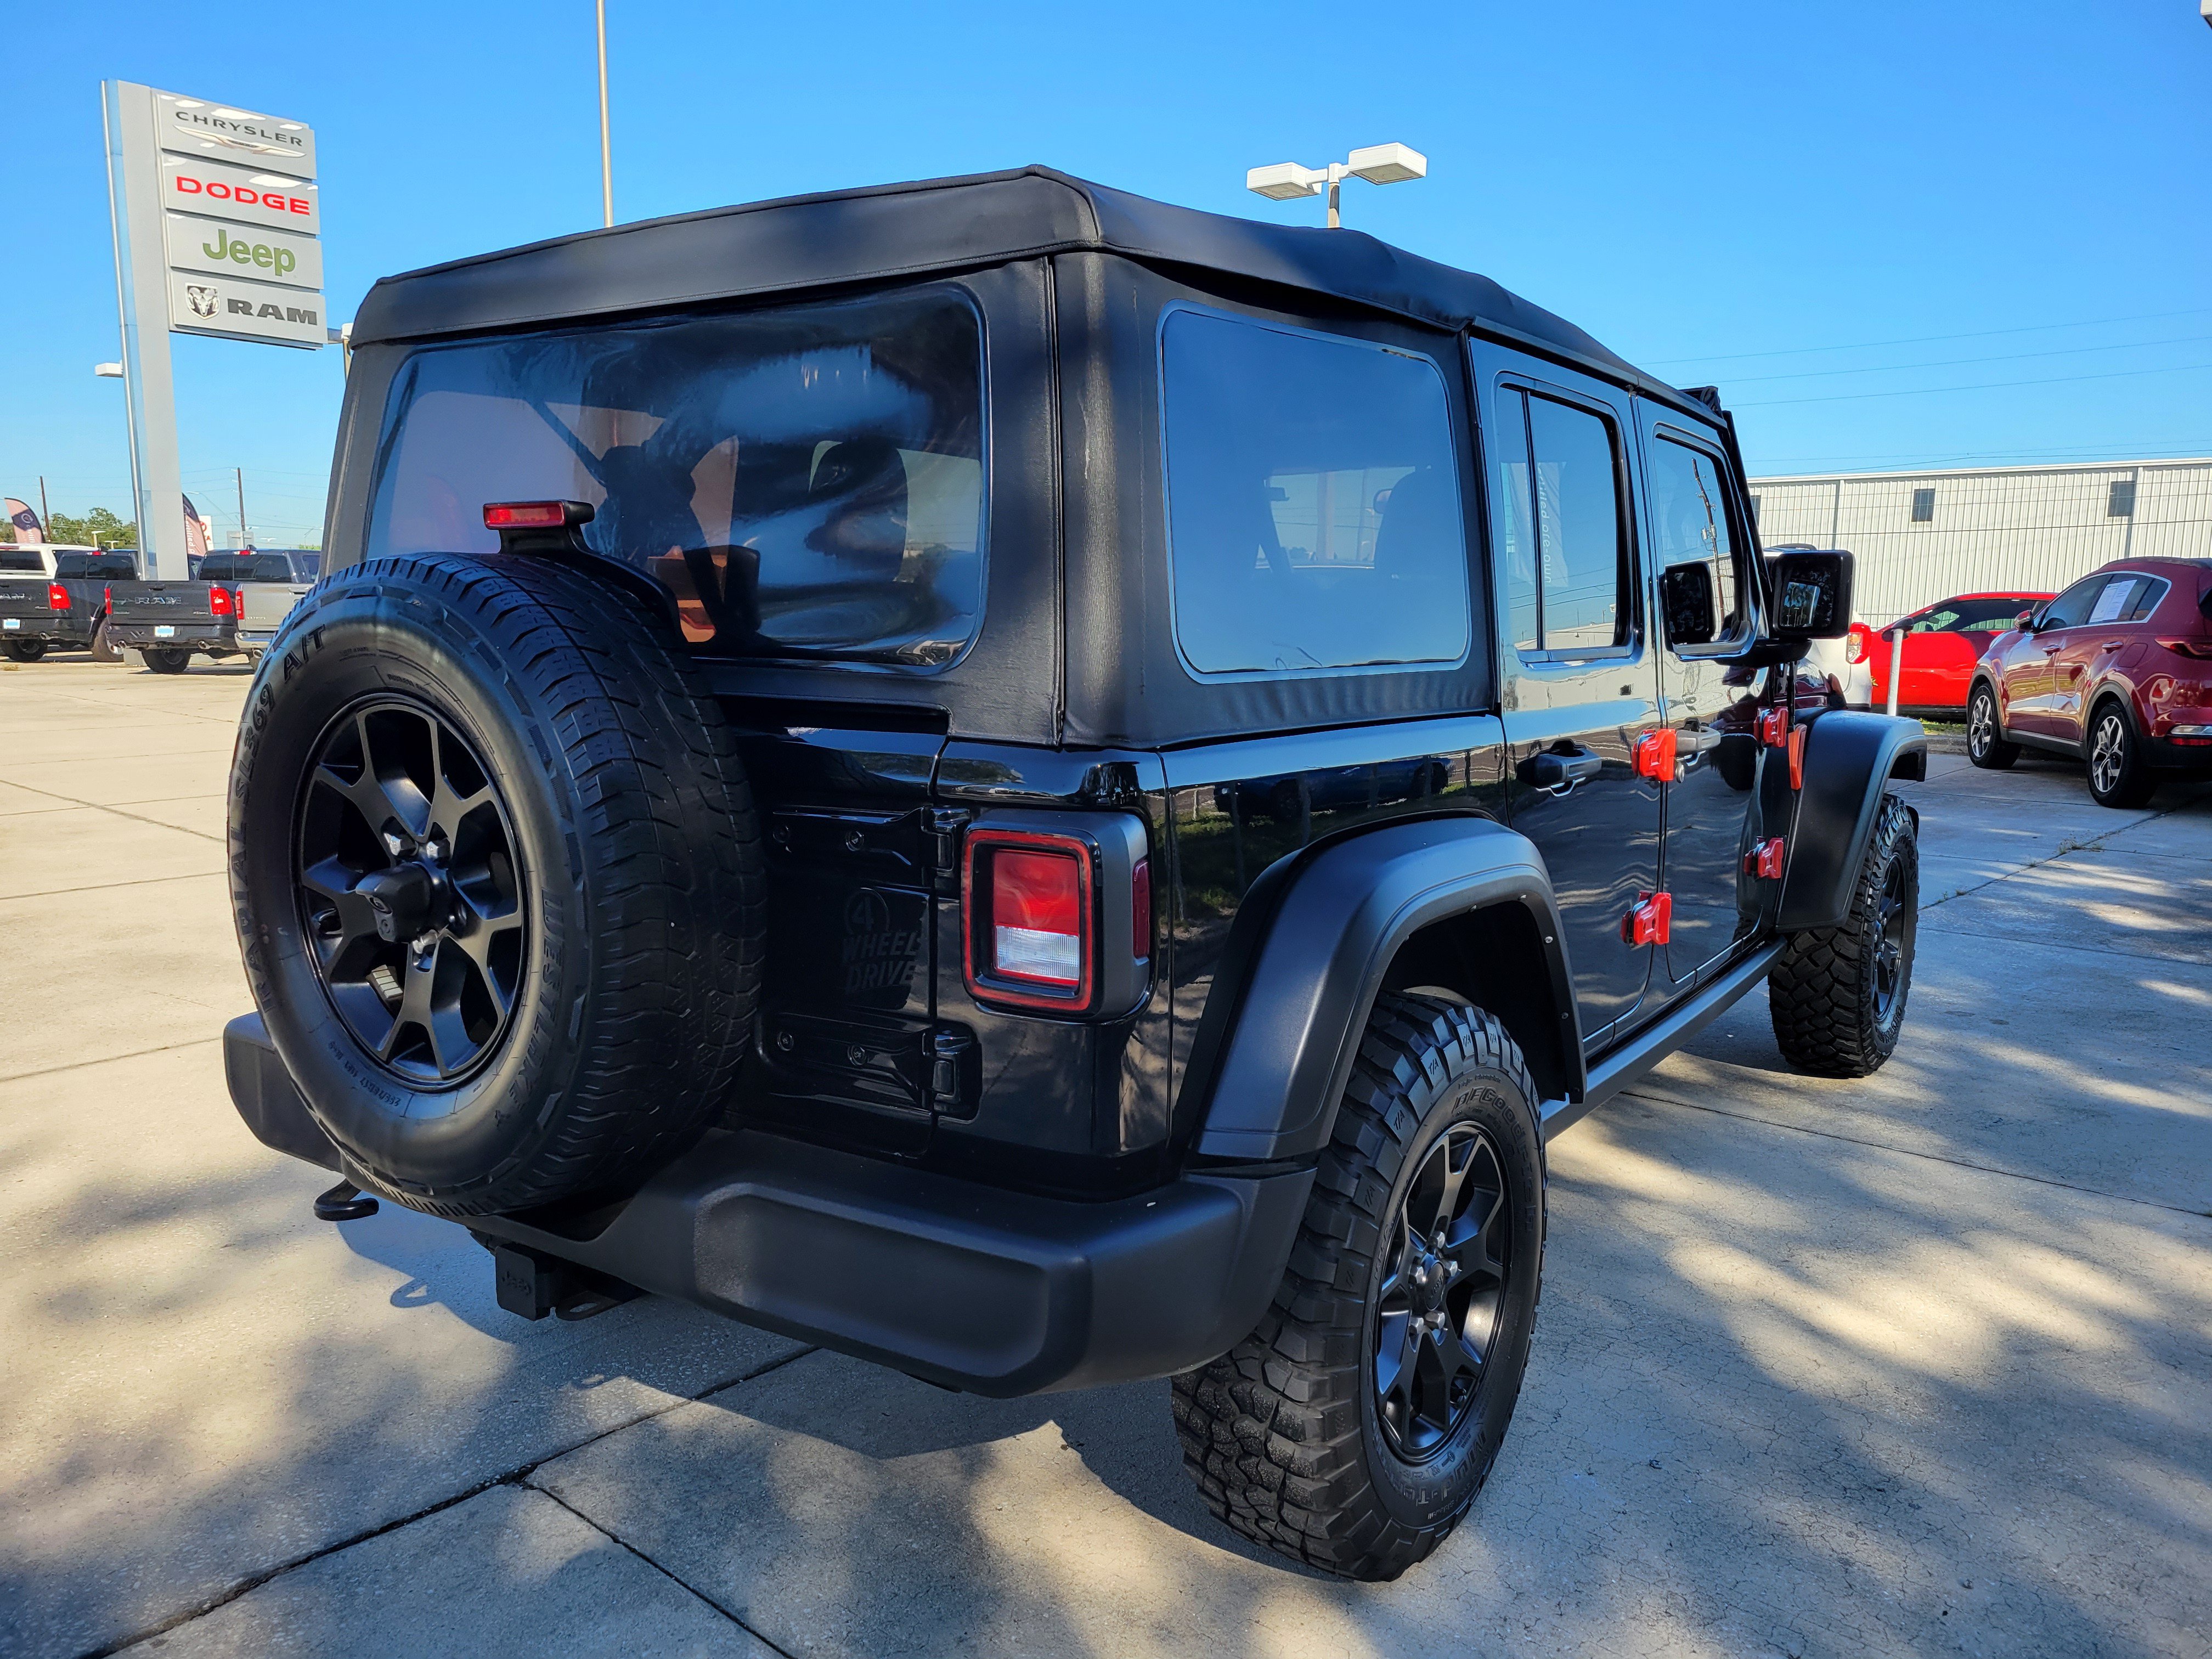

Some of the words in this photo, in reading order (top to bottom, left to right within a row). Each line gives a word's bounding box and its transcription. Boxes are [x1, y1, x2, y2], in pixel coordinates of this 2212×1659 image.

[176, 111, 302, 146] CHRYSLER
[176, 176, 310, 216] DODGE
[202, 229, 295, 276] Jeep
[227, 298, 317, 325] RAM
[134, 596, 182, 605] RAM
[235, 682, 275, 804] SL369
[283, 623, 326, 684] A/T
[846, 960, 917, 992] DRIVE
[1463, 1034, 1471, 1047] T/A
[1428, 1058, 1438, 1075] T/A
[1393, 1109, 1406, 1131] T/A
